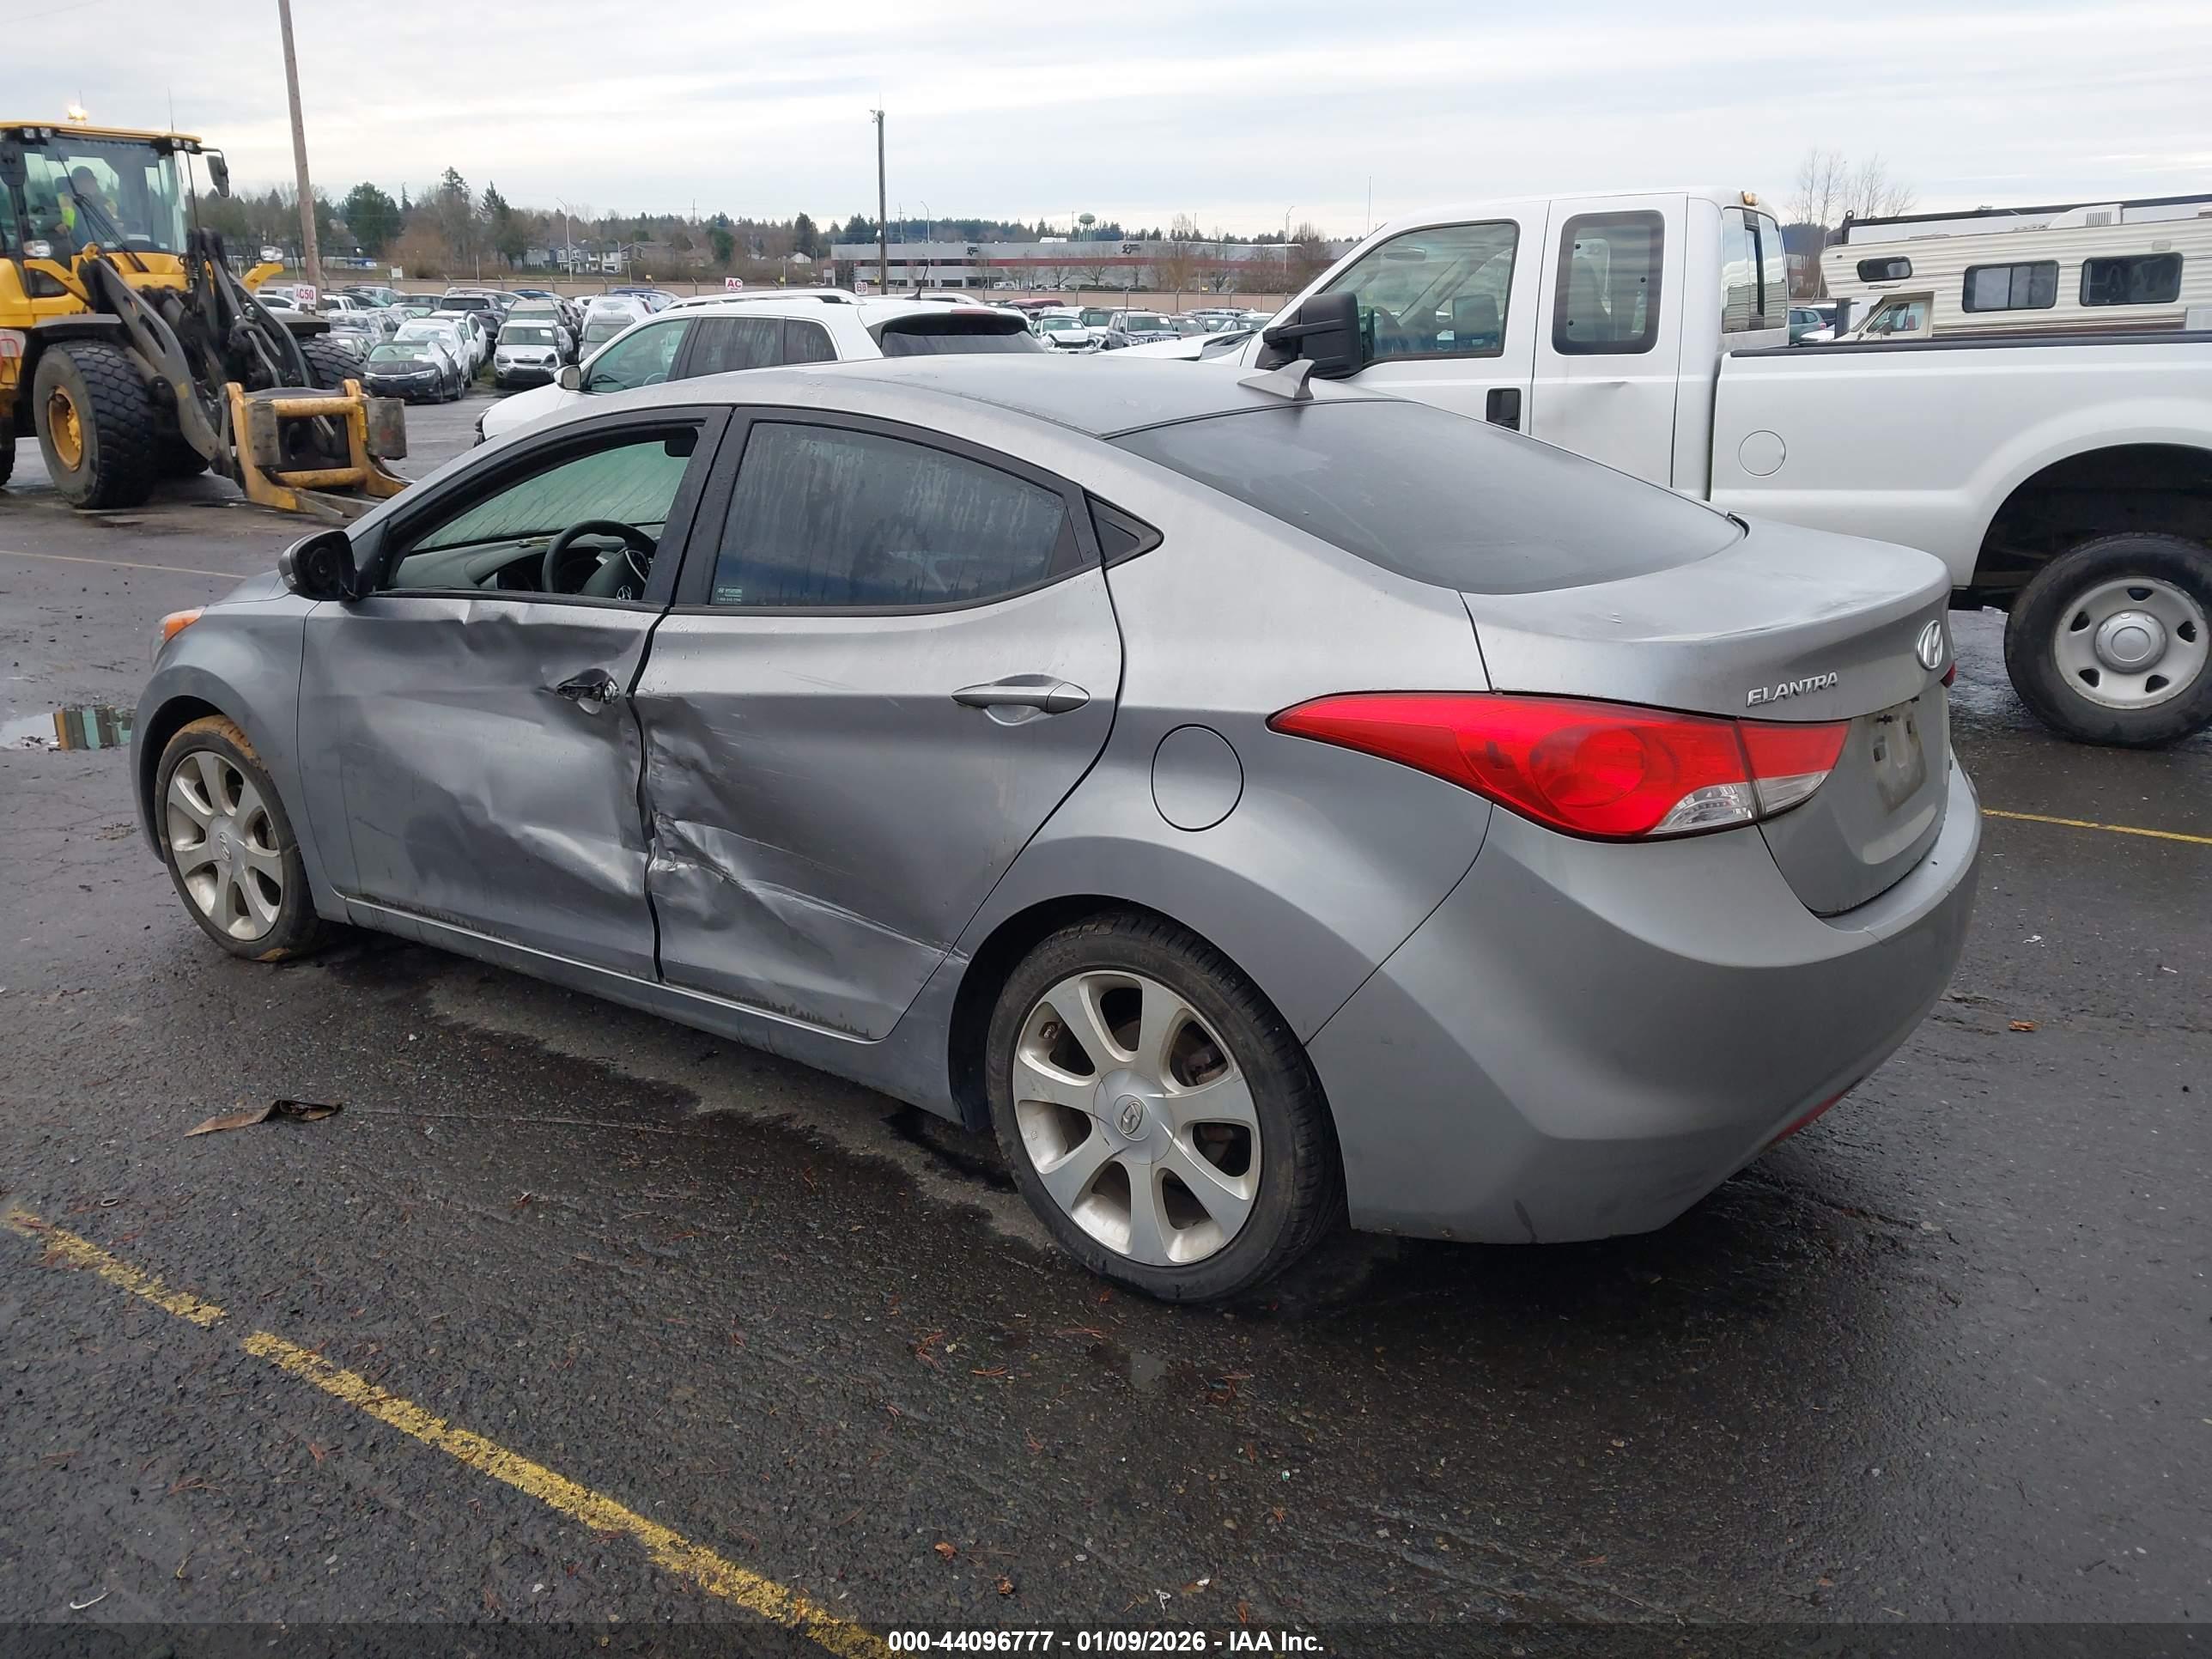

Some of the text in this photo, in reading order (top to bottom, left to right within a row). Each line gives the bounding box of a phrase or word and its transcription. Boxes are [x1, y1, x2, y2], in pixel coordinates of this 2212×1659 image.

[727, 279, 741, 288] AC
[295, 288, 314, 301] AC50
[1747, 672, 1838, 707] ELANTRA
